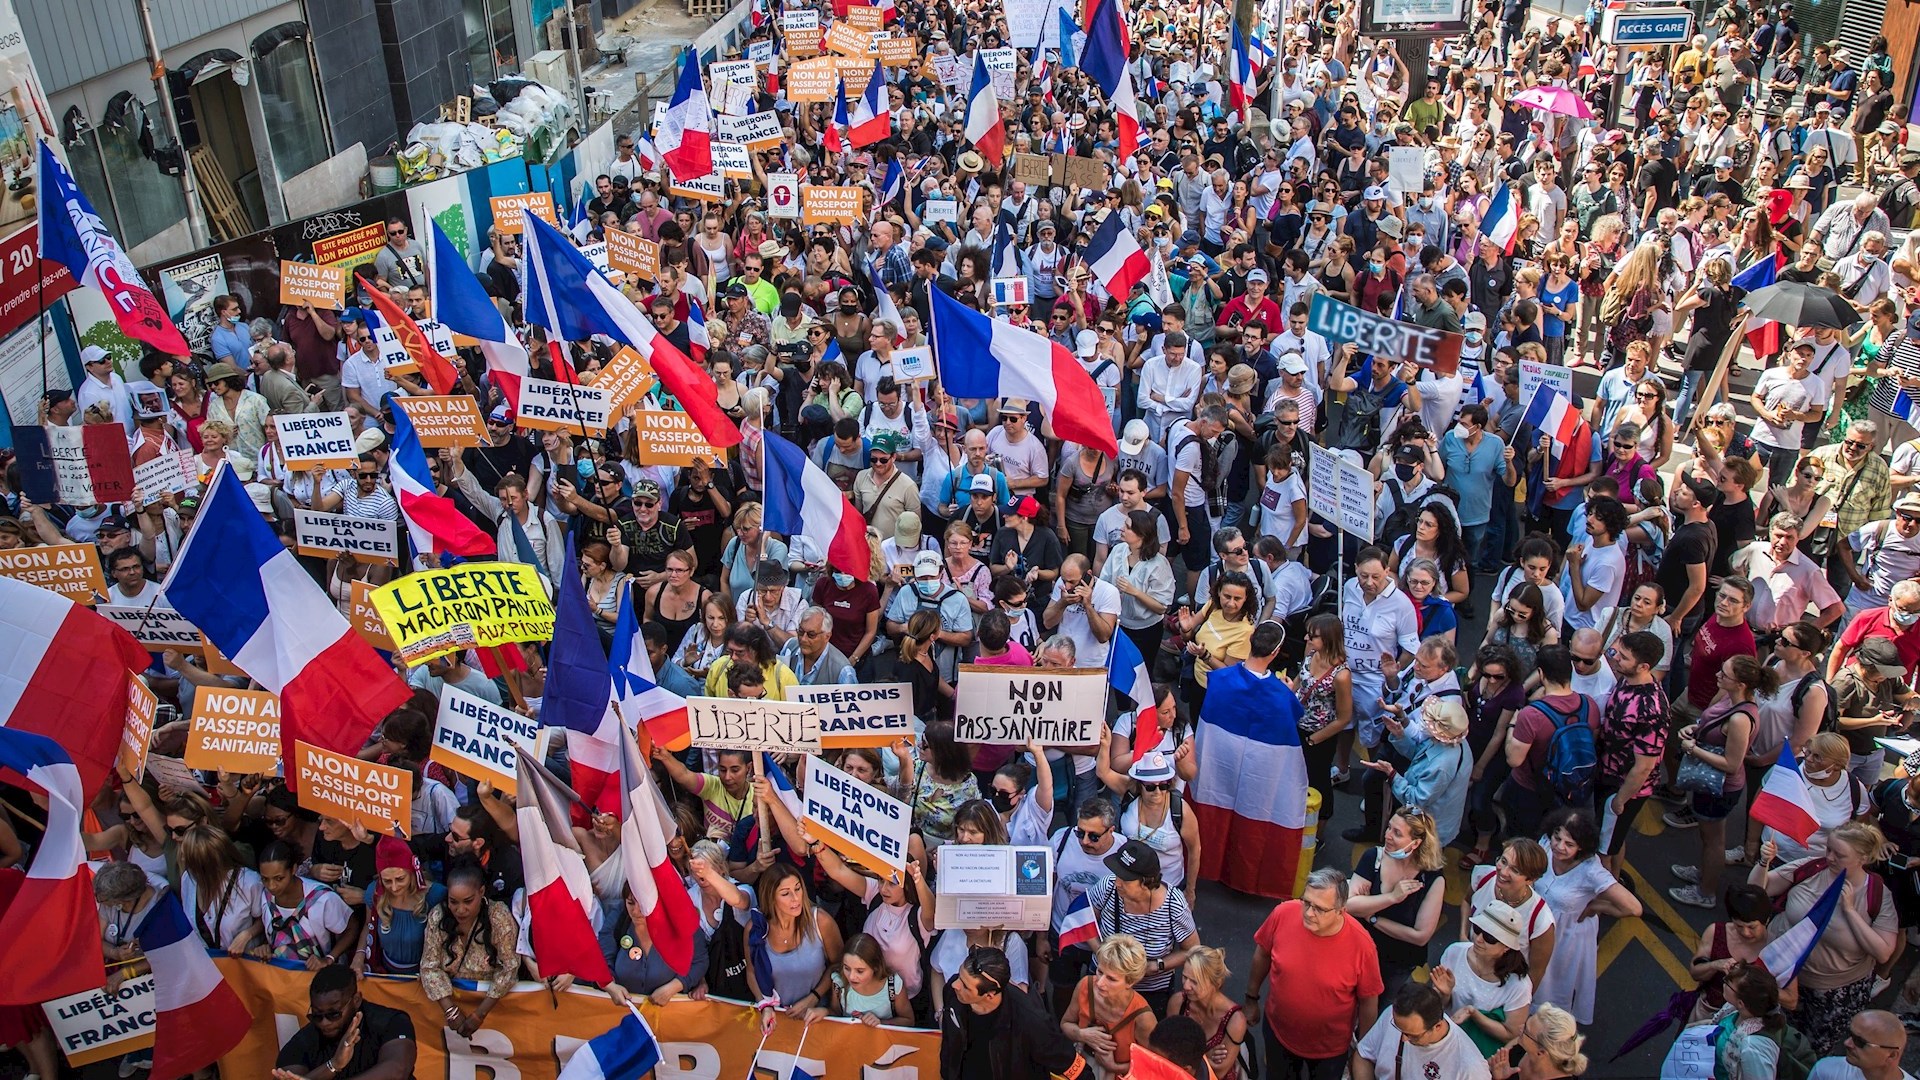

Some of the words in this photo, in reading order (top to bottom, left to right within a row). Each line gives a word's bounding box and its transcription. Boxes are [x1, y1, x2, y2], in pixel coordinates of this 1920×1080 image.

[786, 22, 816, 30] FRANCE!
[836, 25, 854, 35] NON
[856, 32, 868, 42] AU
[1619, 23, 1652, 33] ACCÈS
[1655, 24, 1684, 32] GARE
[831, 31, 867, 49] PASSEPORT
[833, 39, 860, 53] SANITAIRE
[714, 63, 750, 73] LIBÉRONS
[733, 114, 772, 128] LIBÉRONS
[736, 126, 779, 143] FRANCE!
[712, 144, 742, 153] BÉRONS
[712, 160, 747, 168] RANCE!
[529, 196, 546, 206] AU
[810, 190, 837, 198] NON
[840, 190, 856, 199] AU
[322, 242, 336, 251] SITE
[337, 232, 365, 246] PROTÉGÉ
[366, 228, 378, 236] PAR
[611, 232, 636, 248] NON
[638, 241, 653, 254] AU
[318, 252, 336, 264] ADN
[338, 234, 387, 258] PROTECTION
[609, 242, 656, 265] PASSEPORT
[614, 253, 652, 273] SANITAIRE
[289, 265, 318, 278] NON
[322, 270, 339, 280] AU
[284, 276, 341, 291] PASSEPORT
[4, 287, 30, 316] prendre
[290, 288, 335, 299] SANITAIRE
[1318, 301, 1441, 364] LIBERTÉ
[611, 354, 631, 374] AU
[528, 381, 602, 400] LIBÉRONS
[402, 401, 442, 413] NON
[447, 400, 469, 412] AU
[553, 396, 571, 406] LA
[409, 415, 476, 425] ASSEPORT
[522, 405, 603, 422] FRANCE!
[646, 415, 686, 429] NON
[282, 416, 342, 432] LIBÉRONS
[417, 427, 475, 436] SANITAIRE
[305, 430, 322, 440] LA
[642, 430, 707, 443] PASSEPO
[285, 440, 352, 457] FRANCE!
[650, 444, 712, 455] SANITAIRE
[83, 481, 122, 493] VOTER
[304, 516, 386, 531] LIBÉRONS
[334, 527, 355, 537] LA
[302, 535, 392, 552] FRANCE!
[56, 549, 86, 565] AU
[110, 610, 187, 621] LIBÉRON
[397, 600, 490, 641] MACARON
[145, 621, 167, 629] LA
[477, 622, 511, 641] AUX
[798, 688, 900, 704] LIBÉRONS
[1009, 679, 1062, 701] NON
[141, 697, 153, 720] AU
[206, 694, 256, 717] NON
[834, 702, 862, 714] LA
[1013, 700, 1042, 715] AU
[195, 717, 280, 738] PASSEPOR
[450, 698, 538, 740] LIBÉRONS
[818, 714, 907, 732] RANCE!
[476, 722, 499, 742] LA
[201, 736, 279, 756] SANITAIRE
[307, 751, 360, 780] NON
[365, 769, 399, 790] AU
[301, 768, 403, 808] PASSEPORT
[815, 769, 900, 820] LIBÉRONS
[312, 785, 392, 820] SANITAIRE
[842, 796, 864, 818] LA
[808, 798, 900, 859] FRANCE!
[97, 1003, 129, 1021] LA
